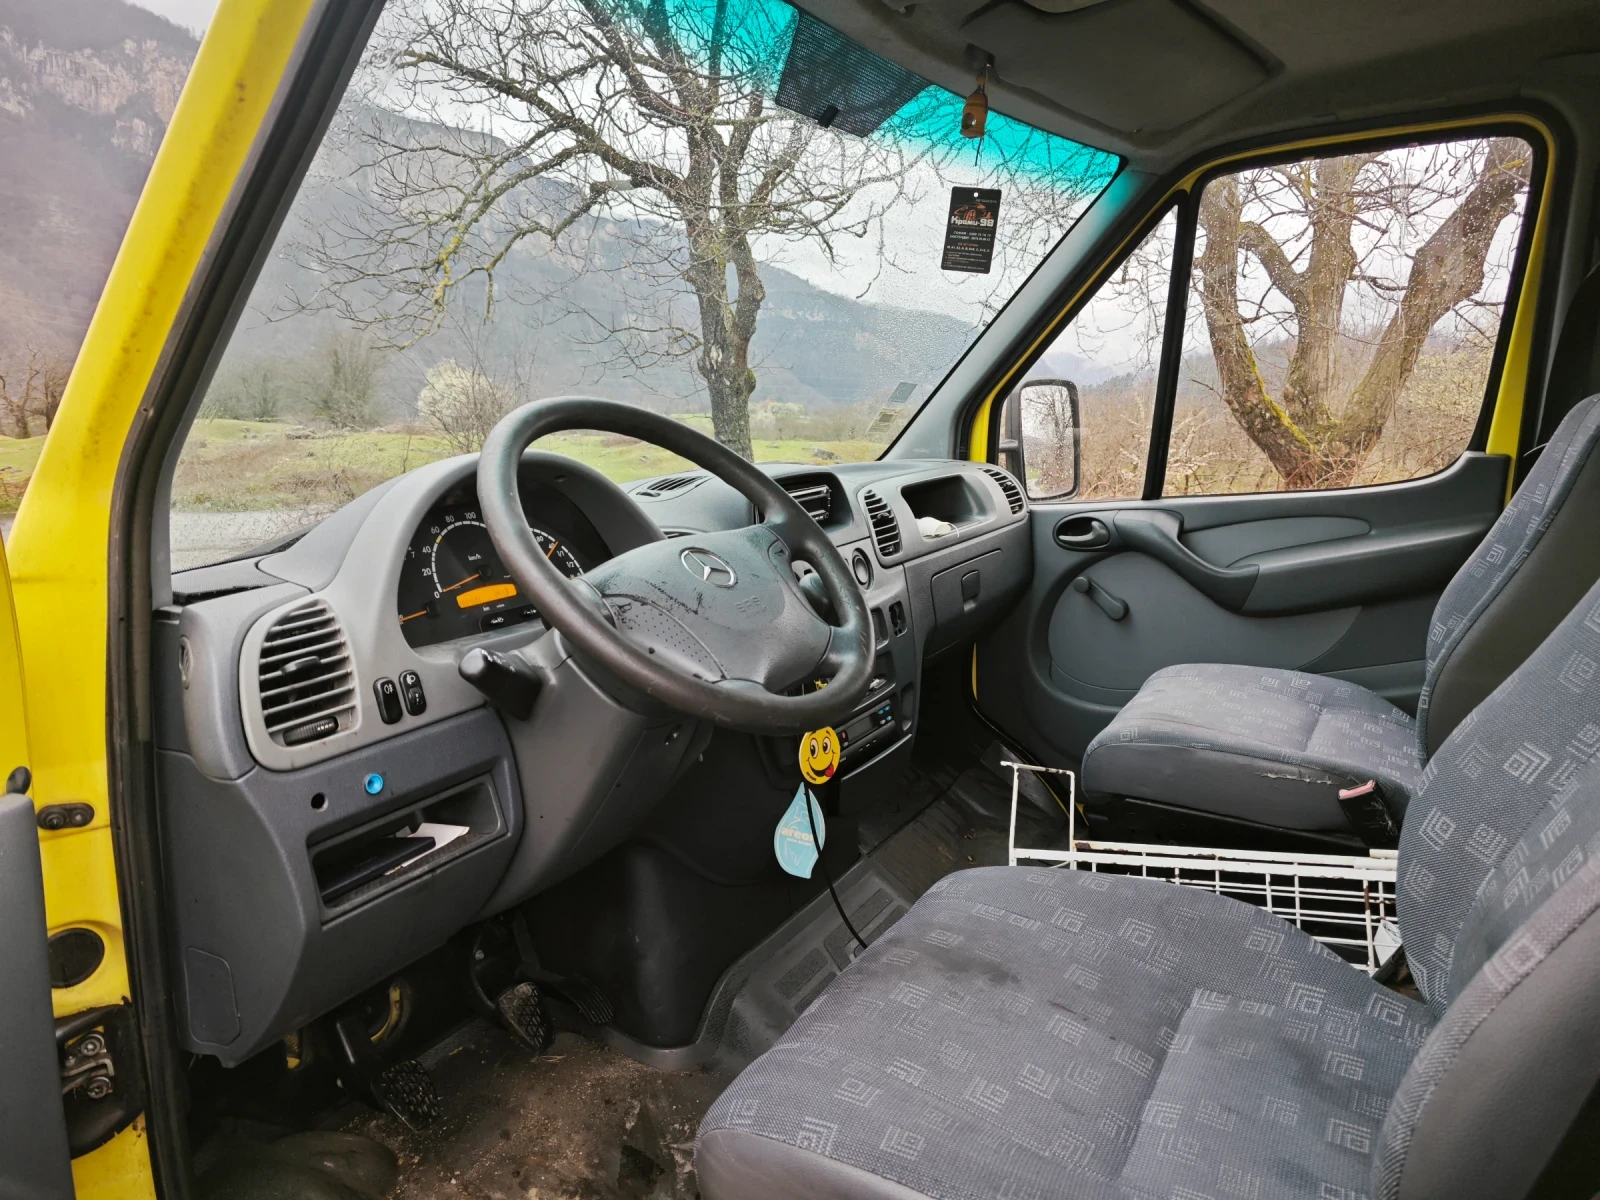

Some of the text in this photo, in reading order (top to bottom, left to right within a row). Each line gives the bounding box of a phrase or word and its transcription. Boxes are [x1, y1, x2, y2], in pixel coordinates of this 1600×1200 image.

[445, 515, 455, 523] 80
[464, 511, 477, 520] 100
[431, 526, 440, 534] 60
[422, 545, 431, 554] 40
[468, 553, 482, 561] km/h
[422, 567, 432, 577] 20
[433, 591, 440, 599] 0
